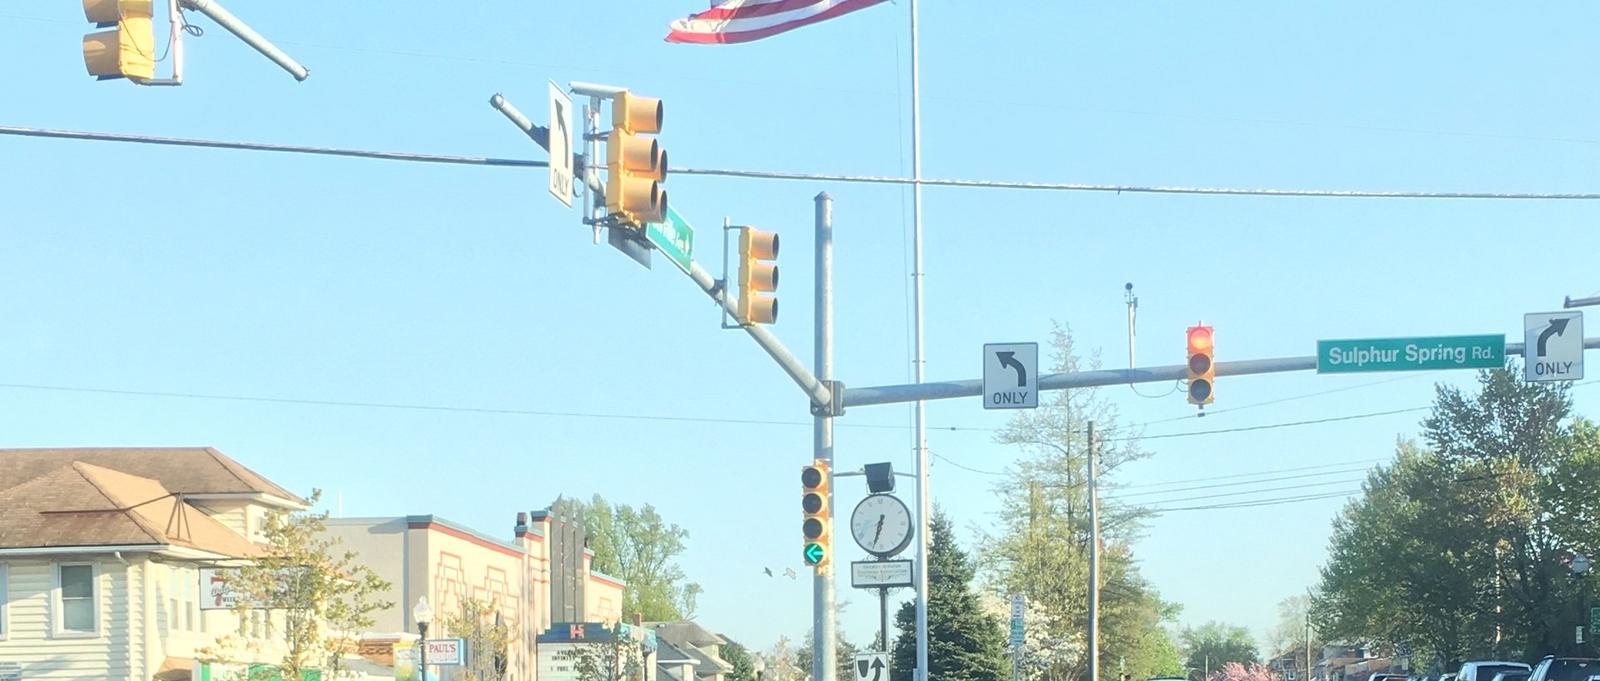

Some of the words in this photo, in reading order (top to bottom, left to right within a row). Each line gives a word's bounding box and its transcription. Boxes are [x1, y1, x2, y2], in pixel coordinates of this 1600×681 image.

[553, 168, 569, 197] ONLY
[1328, 346, 1399, 366] Sulphur
[1405, 344, 1466, 364] Spring
[1472, 347, 1495, 360] Rd.
[1535, 361, 1573, 375] ONLY
[993, 391, 1028, 405] ONLY
[429, 644, 456, 653] PAUL'S
